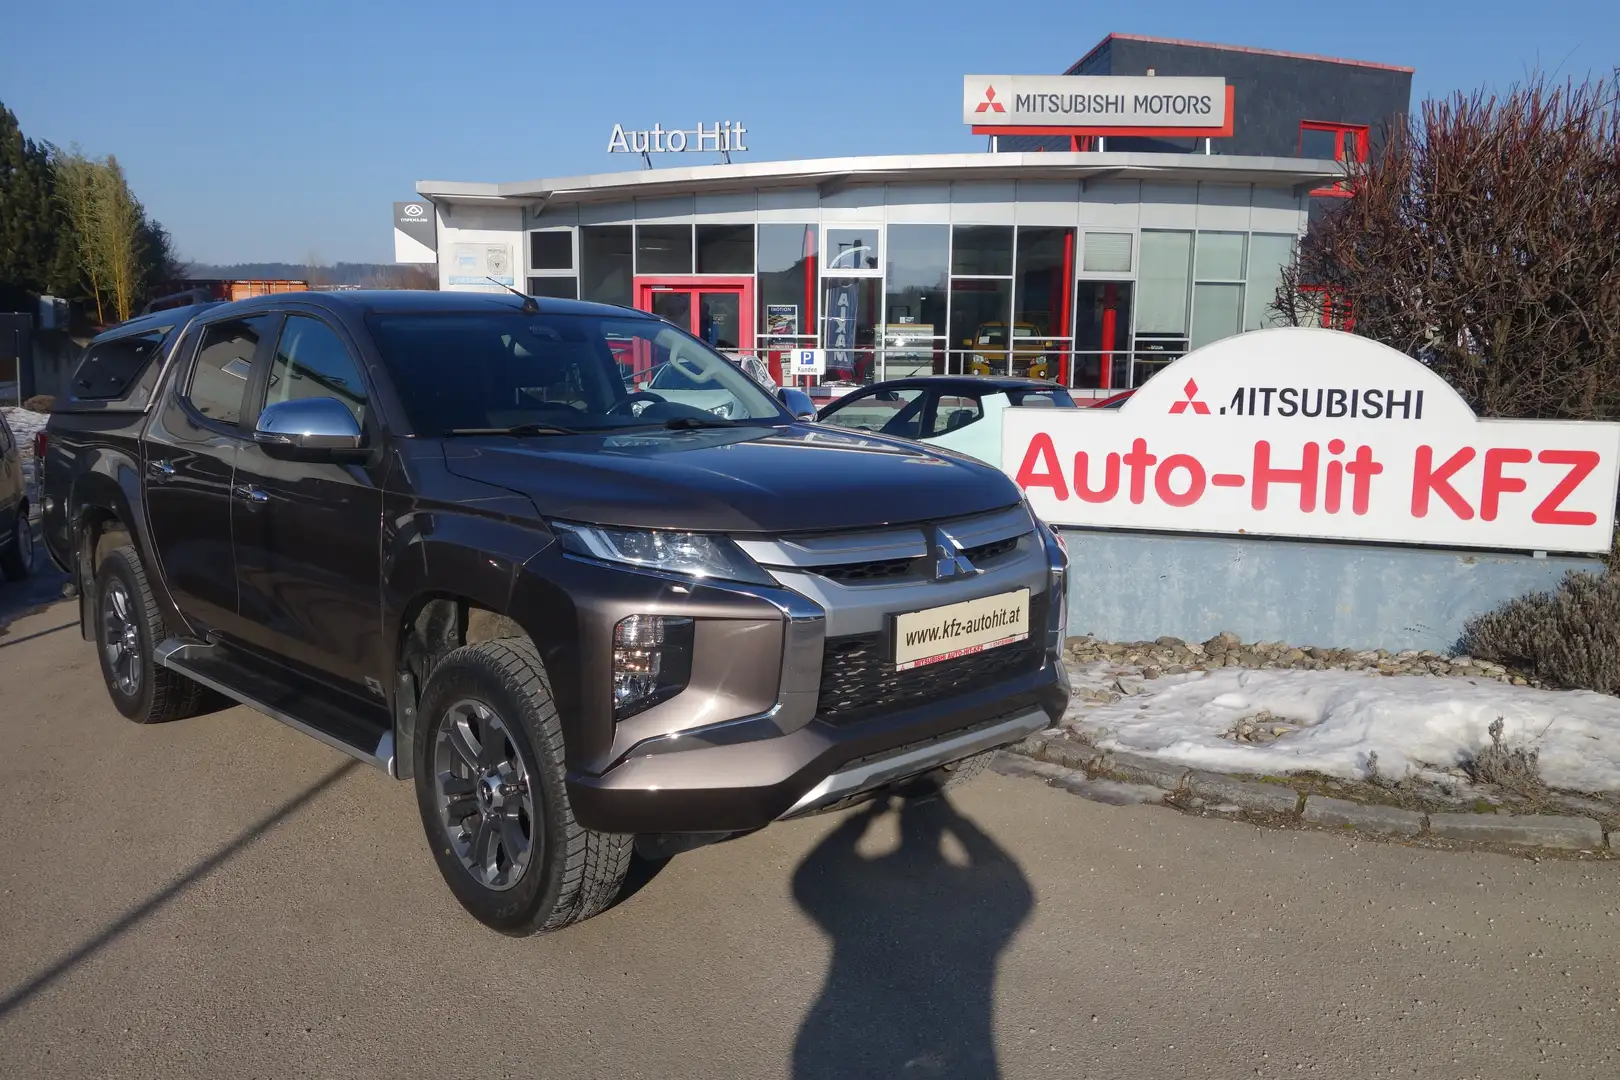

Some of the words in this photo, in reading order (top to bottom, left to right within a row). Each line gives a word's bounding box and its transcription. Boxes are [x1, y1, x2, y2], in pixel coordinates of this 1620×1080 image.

[1015, 93, 1125, 114] MITSUBISHI
[1133, 94, 1212, 115] MOTORS
[607, 122, 687, 152] Auto
[697, 120, 748, 151] Hit
[833, 292, 849, 362] AIXAM
[1016, 431, 1384, 516] Auto-Hit
[1411, 444, 1601, 526] KFZ
[905, 605, 1021, 647] www.kfz-autohit.at
